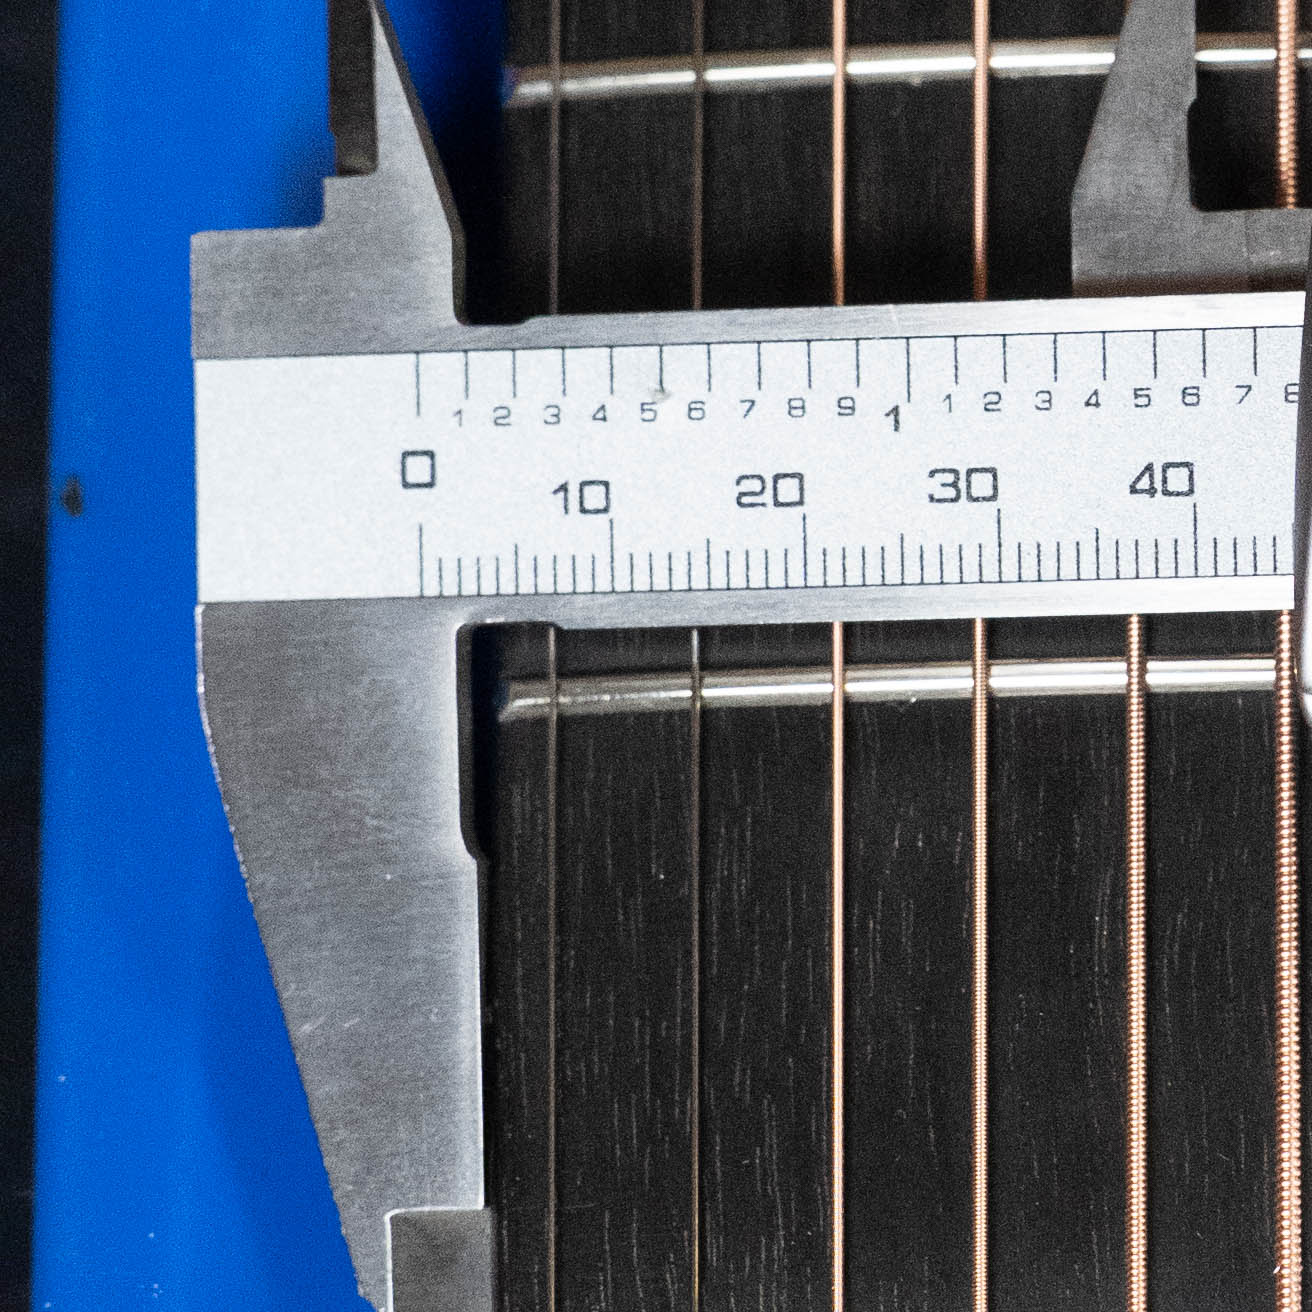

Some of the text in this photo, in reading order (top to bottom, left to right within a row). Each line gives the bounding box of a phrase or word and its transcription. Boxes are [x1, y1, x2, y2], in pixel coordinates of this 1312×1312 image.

[493, 405, 511, 427] 2
[543, 404, 561, 426] 3
[591, 403, 608, 423] 4
[640, 401, 657, 423] 5
[687, 400, 706, 421] 6
[739, 398, 756, 419] 7
[787, 397, 806, 418] 8
[837, 396, 856, 417] 9
[884, 404, 901, 433] 1
[943, 393, 953, 413] 1
[983, 390, 1002, 413] 2
[1034, 389, 1053, 412] 3
[1083, 388, 1102, 409] 4
[1133, 386, 1152, 409] 5
[1181, 385, 1201, 407] 6
[1234, 384, 1253, 405] 7
[400, 449, 437, 490] 0
[551, 460, 1196, 516] 10 20 30 40
